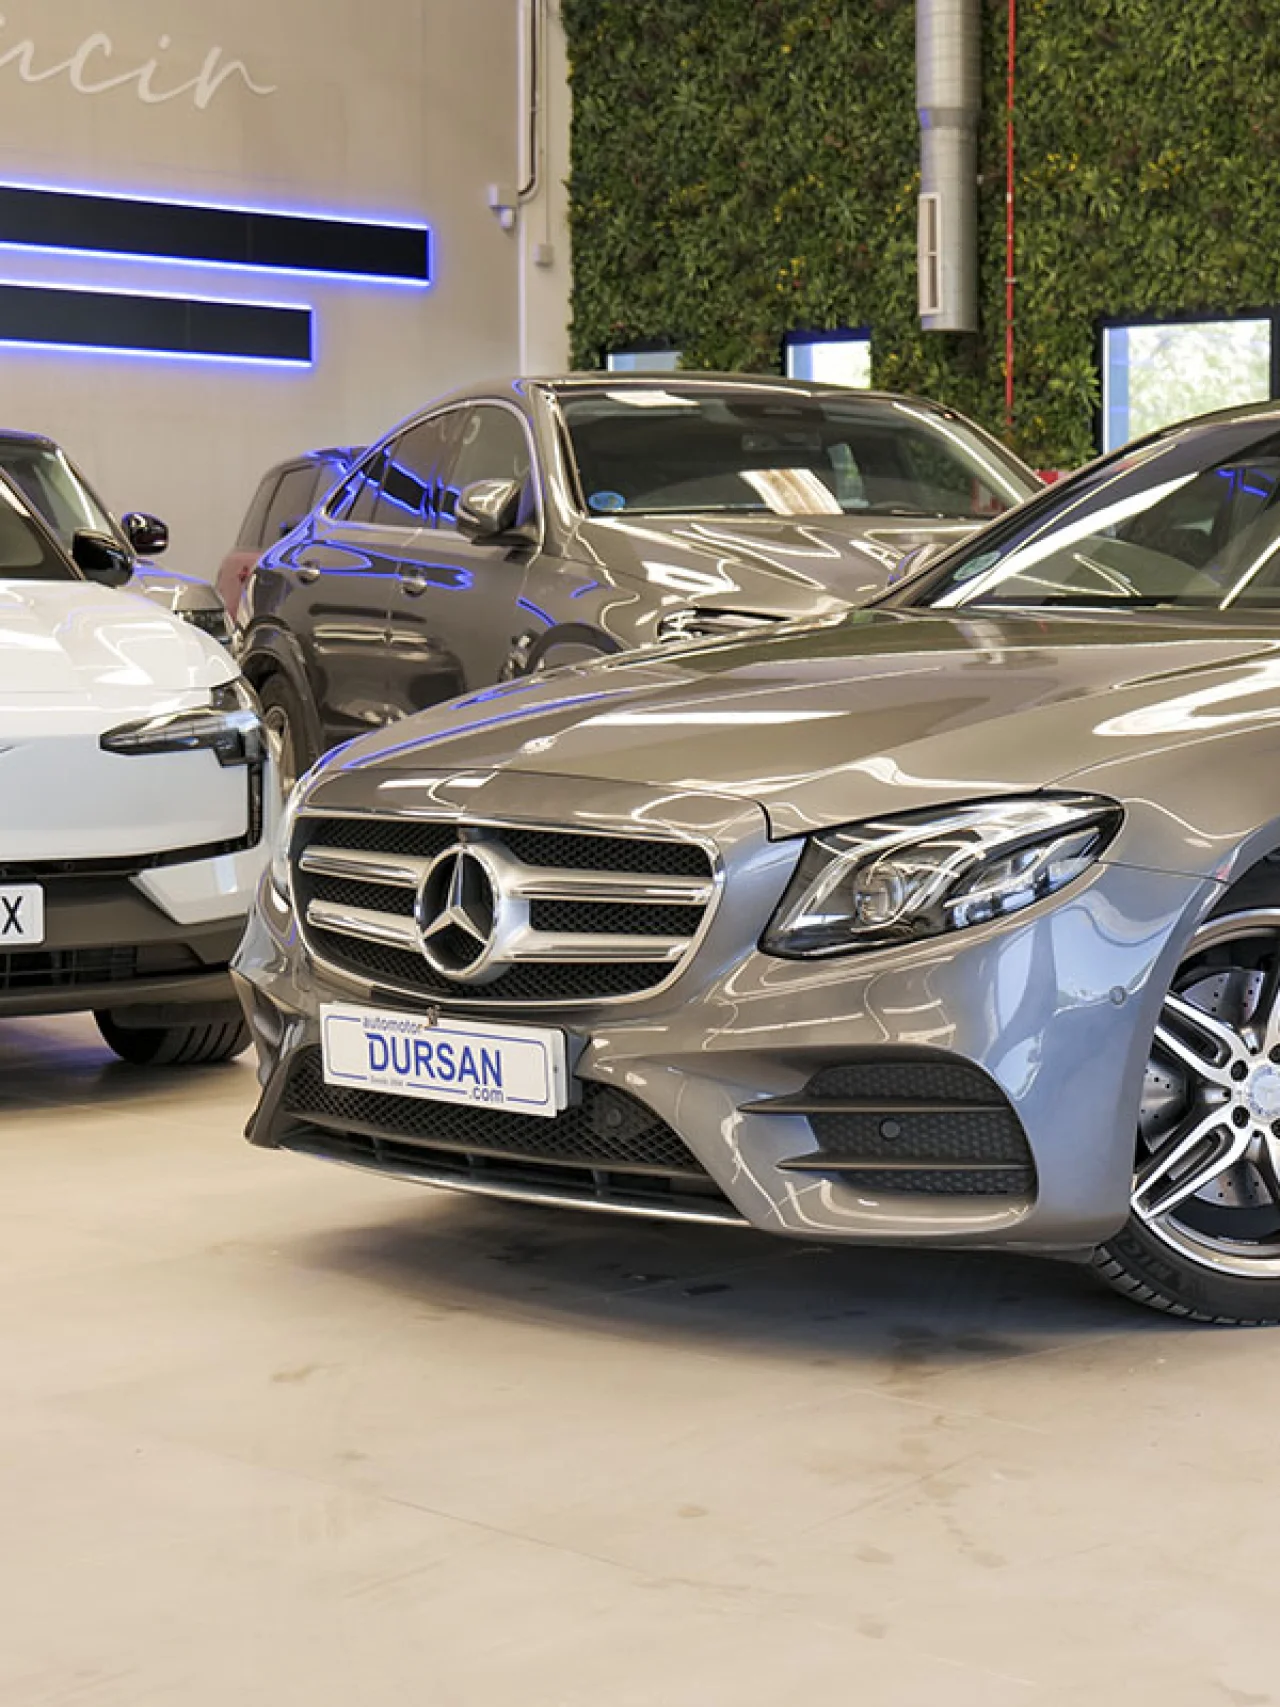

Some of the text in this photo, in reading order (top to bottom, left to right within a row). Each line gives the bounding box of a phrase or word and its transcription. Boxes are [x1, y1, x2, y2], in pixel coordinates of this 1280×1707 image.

[1, 895, 24, 935] X
[362, 1015, 423, 1034] automotor
[365, 1032, 503, 1087] DURSAN
[468, 1086, 505, 1104] .com
